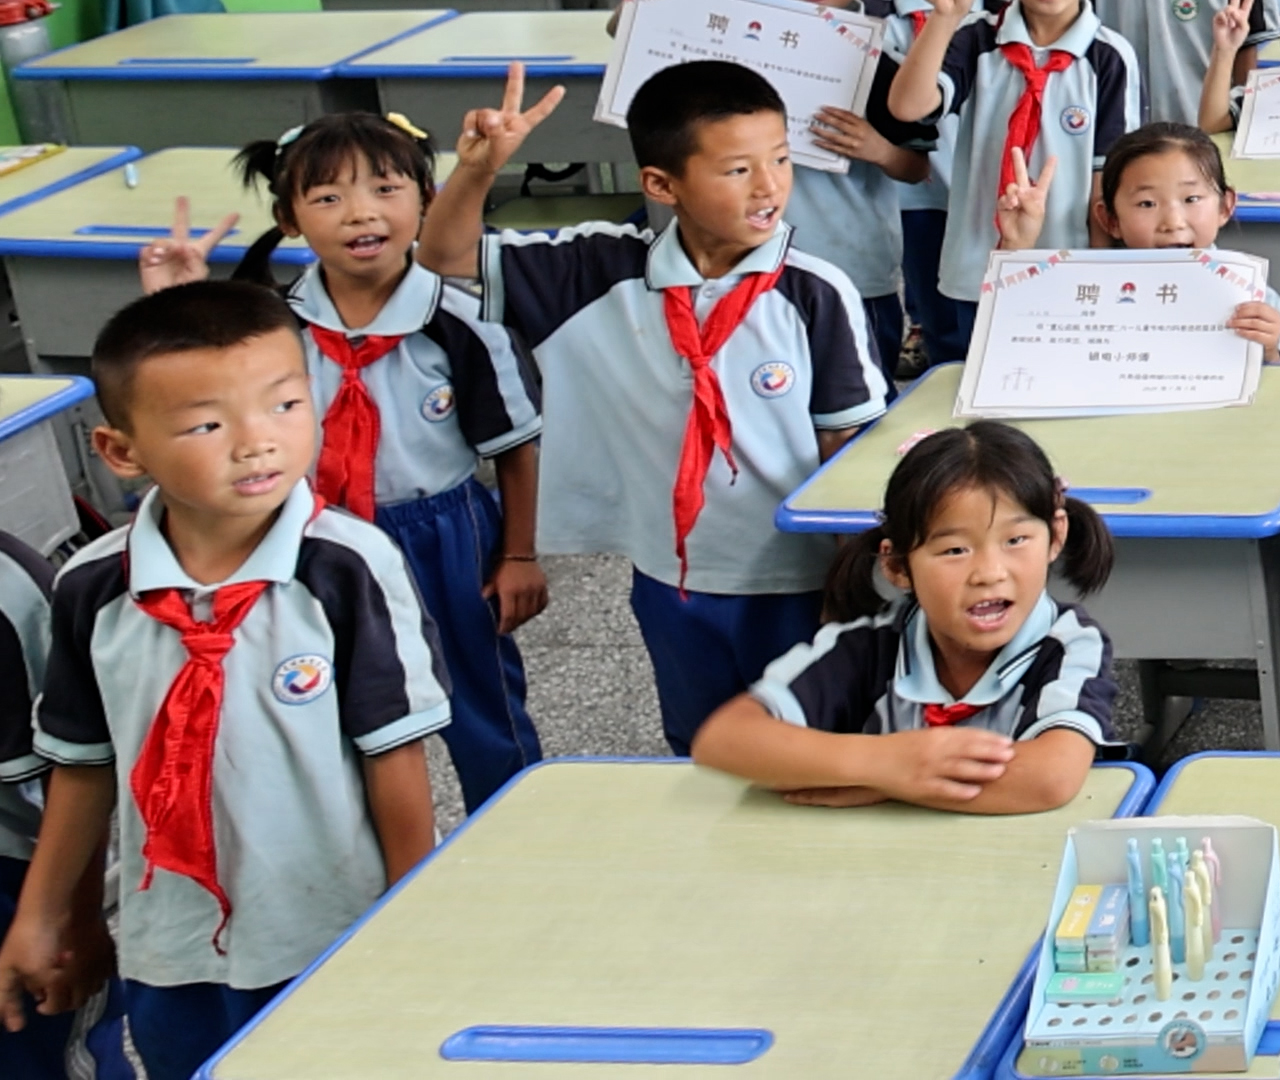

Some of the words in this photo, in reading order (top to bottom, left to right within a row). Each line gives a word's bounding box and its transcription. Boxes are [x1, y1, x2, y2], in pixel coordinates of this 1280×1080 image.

[706, 12, 730, 35] 聘
[779, 29, 801, 49] 书
[1075, 283, 1101, 305] 聘
[1156, 283, 1178, 305] 书
